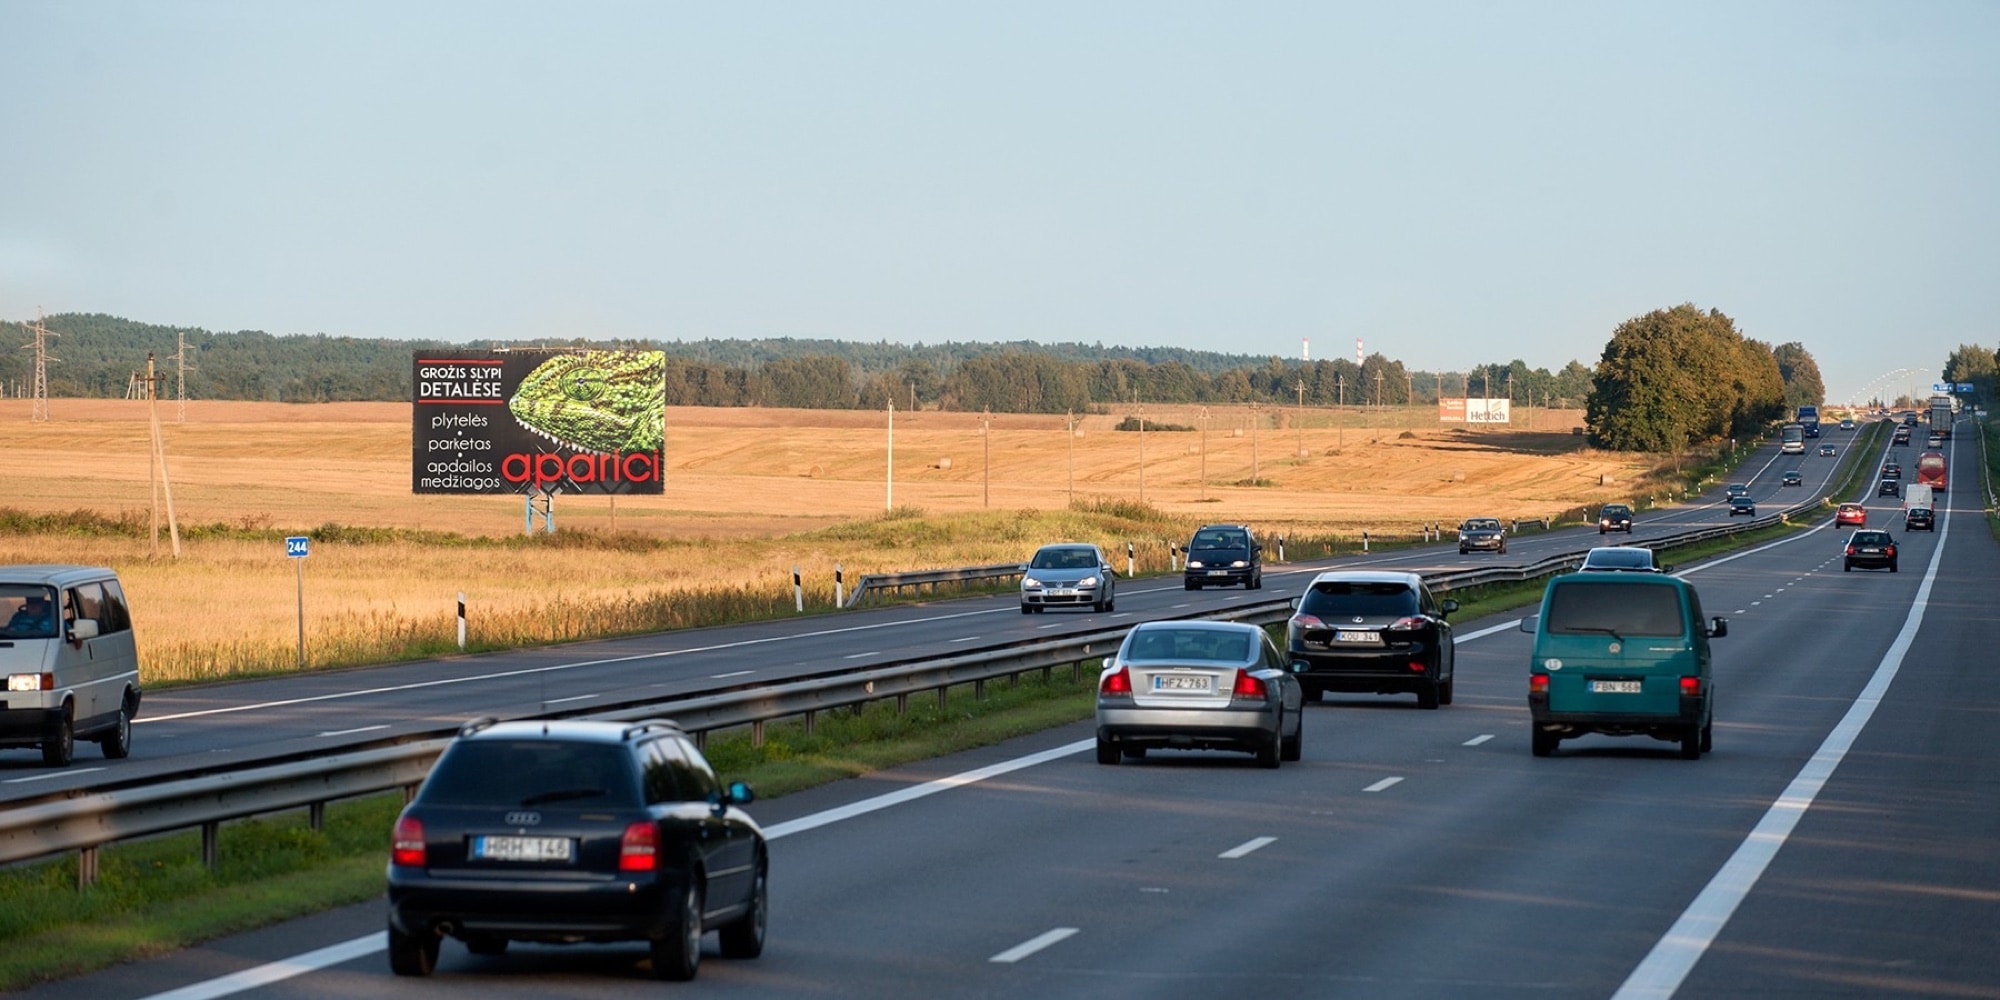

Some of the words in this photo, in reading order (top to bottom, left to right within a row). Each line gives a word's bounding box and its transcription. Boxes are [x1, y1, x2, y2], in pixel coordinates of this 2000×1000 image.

[470, 367, 502, 379] SLYPI
[420, 379, 502, 397] DETALĖSE
[431, 412, 488, 429] plytelės
[1470, 411, 1506, 421] Hettich
[428, 438, 492, 452] parketas
[427, 459, 493, 475] apdailos
[501, 447, 660, 490] aparici
[421, 474, 500, 490] medžiagos
[288, 541, 307, 553] 244
[1341, 632, 1360, 641] KOU
[1162, 678, 1182, 689] HFZ
[1189, 679, 1208, 689] 763
